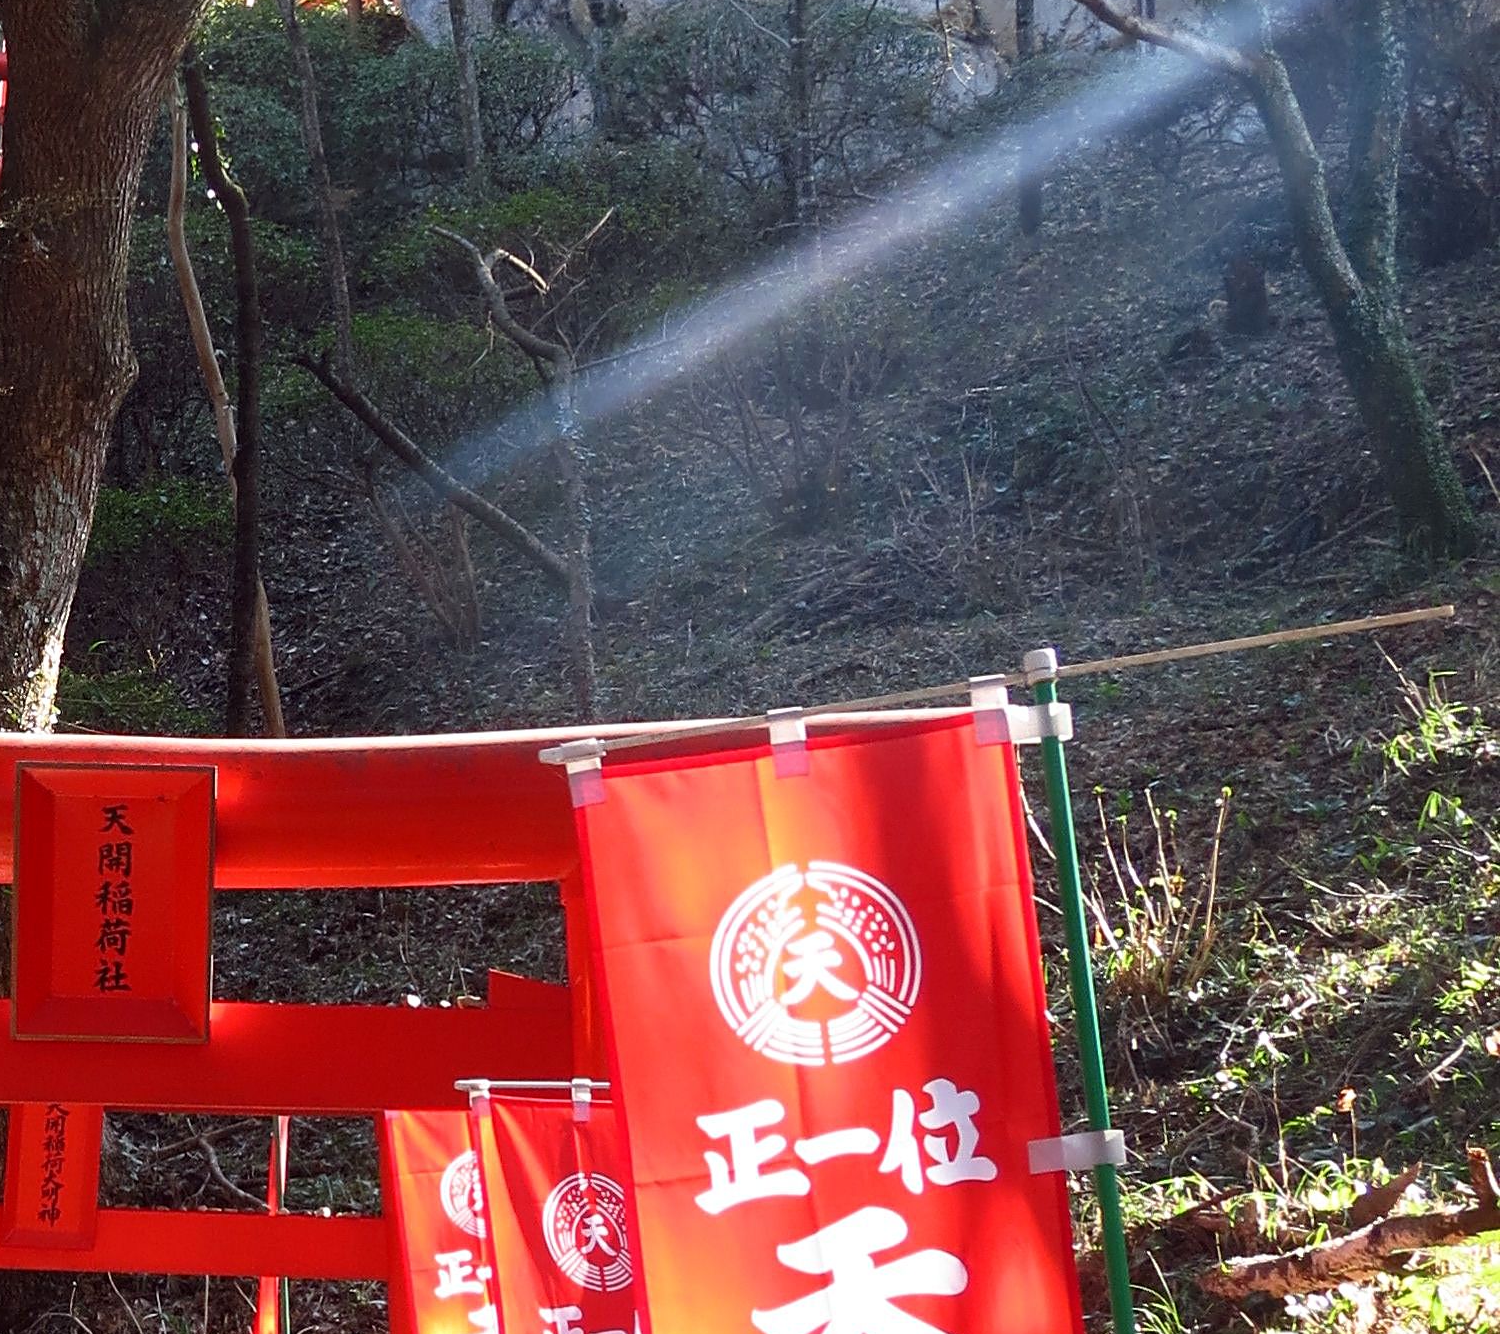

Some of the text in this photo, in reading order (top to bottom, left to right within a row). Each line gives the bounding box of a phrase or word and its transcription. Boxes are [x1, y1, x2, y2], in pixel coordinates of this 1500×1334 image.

[93, 803, 136, 994] 天開稲荷社
[695, 1078, 998, 1215] 正一位
